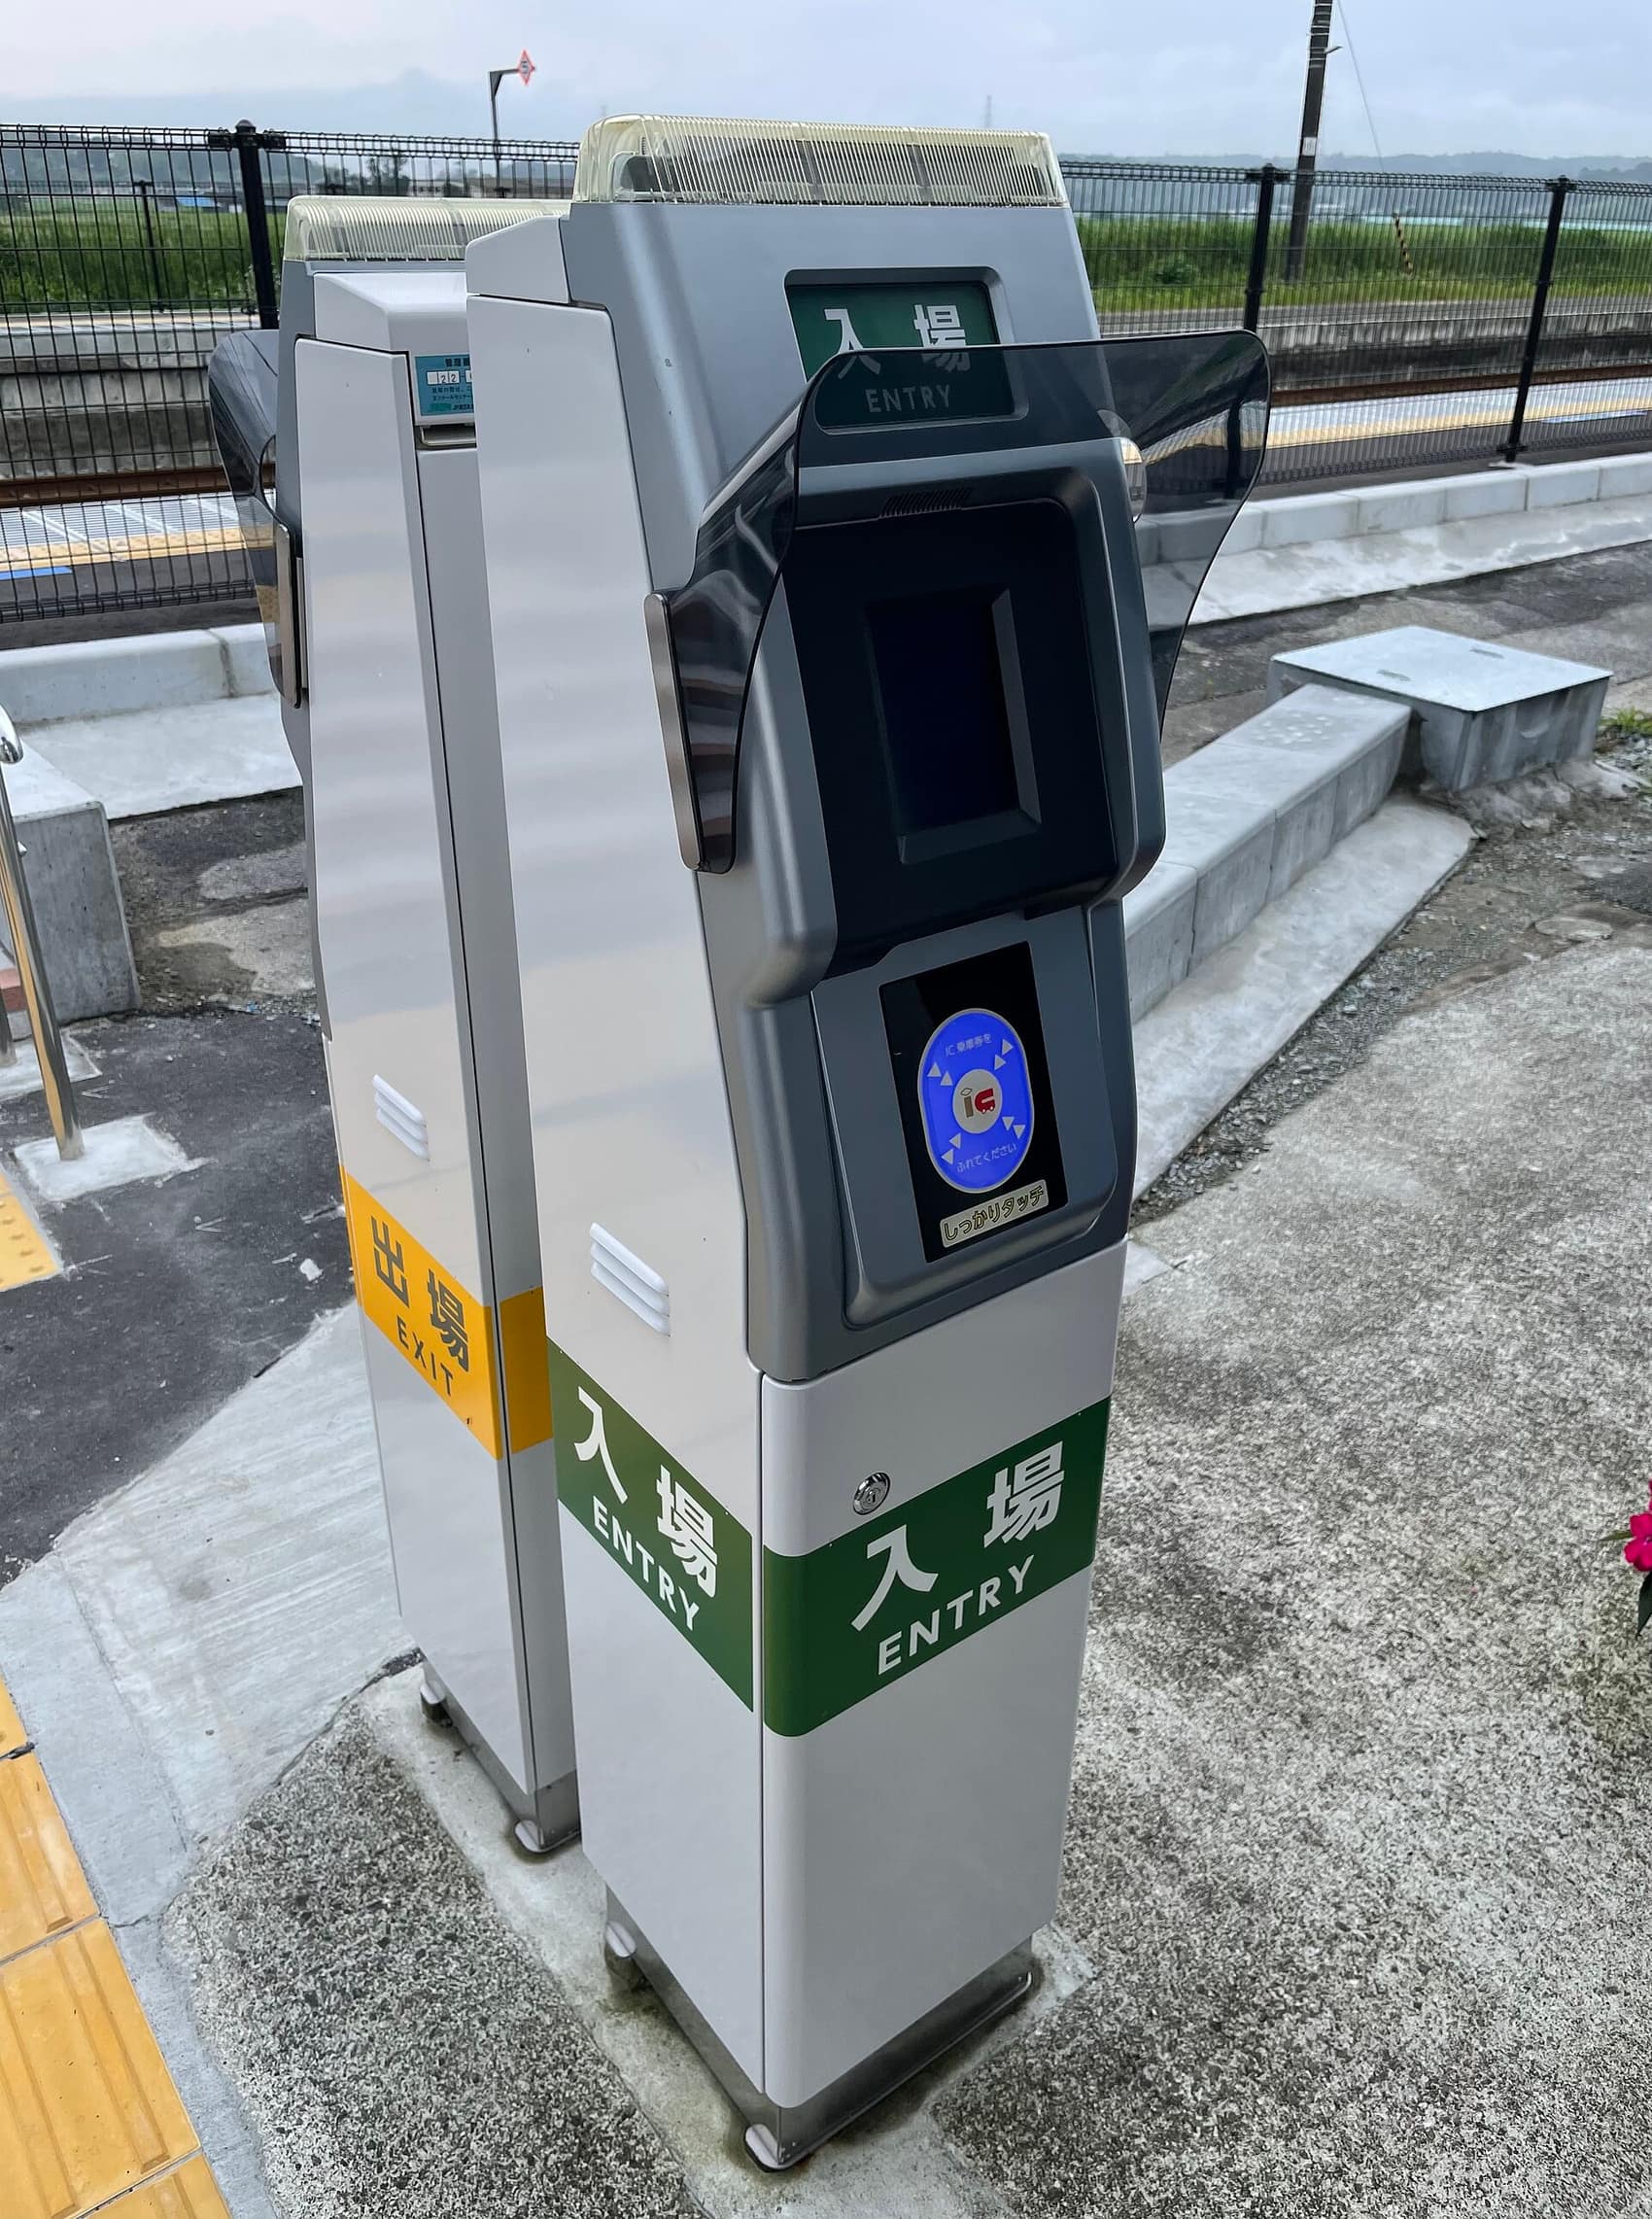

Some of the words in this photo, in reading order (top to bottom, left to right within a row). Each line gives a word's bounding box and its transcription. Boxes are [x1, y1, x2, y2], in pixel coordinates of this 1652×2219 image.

[823, 303, 971, 379] 入場
[864, 384, 951, 413] ENTRY
[956, 1142, 1017, 1173] ふれてください
[944, 1185, 1045, 1241] しっかりタッチ
[370, 1215, 469, 1372] 出場
[396, 1314, 454, 1397] EXIT
[574, 1386, 717, 1599] 入場
[850, 1440, 1065, 1632] 入場
[593, 1495, 700, 1632] ENTRY
[878, 1554, 1035, 1676] ENTRY
